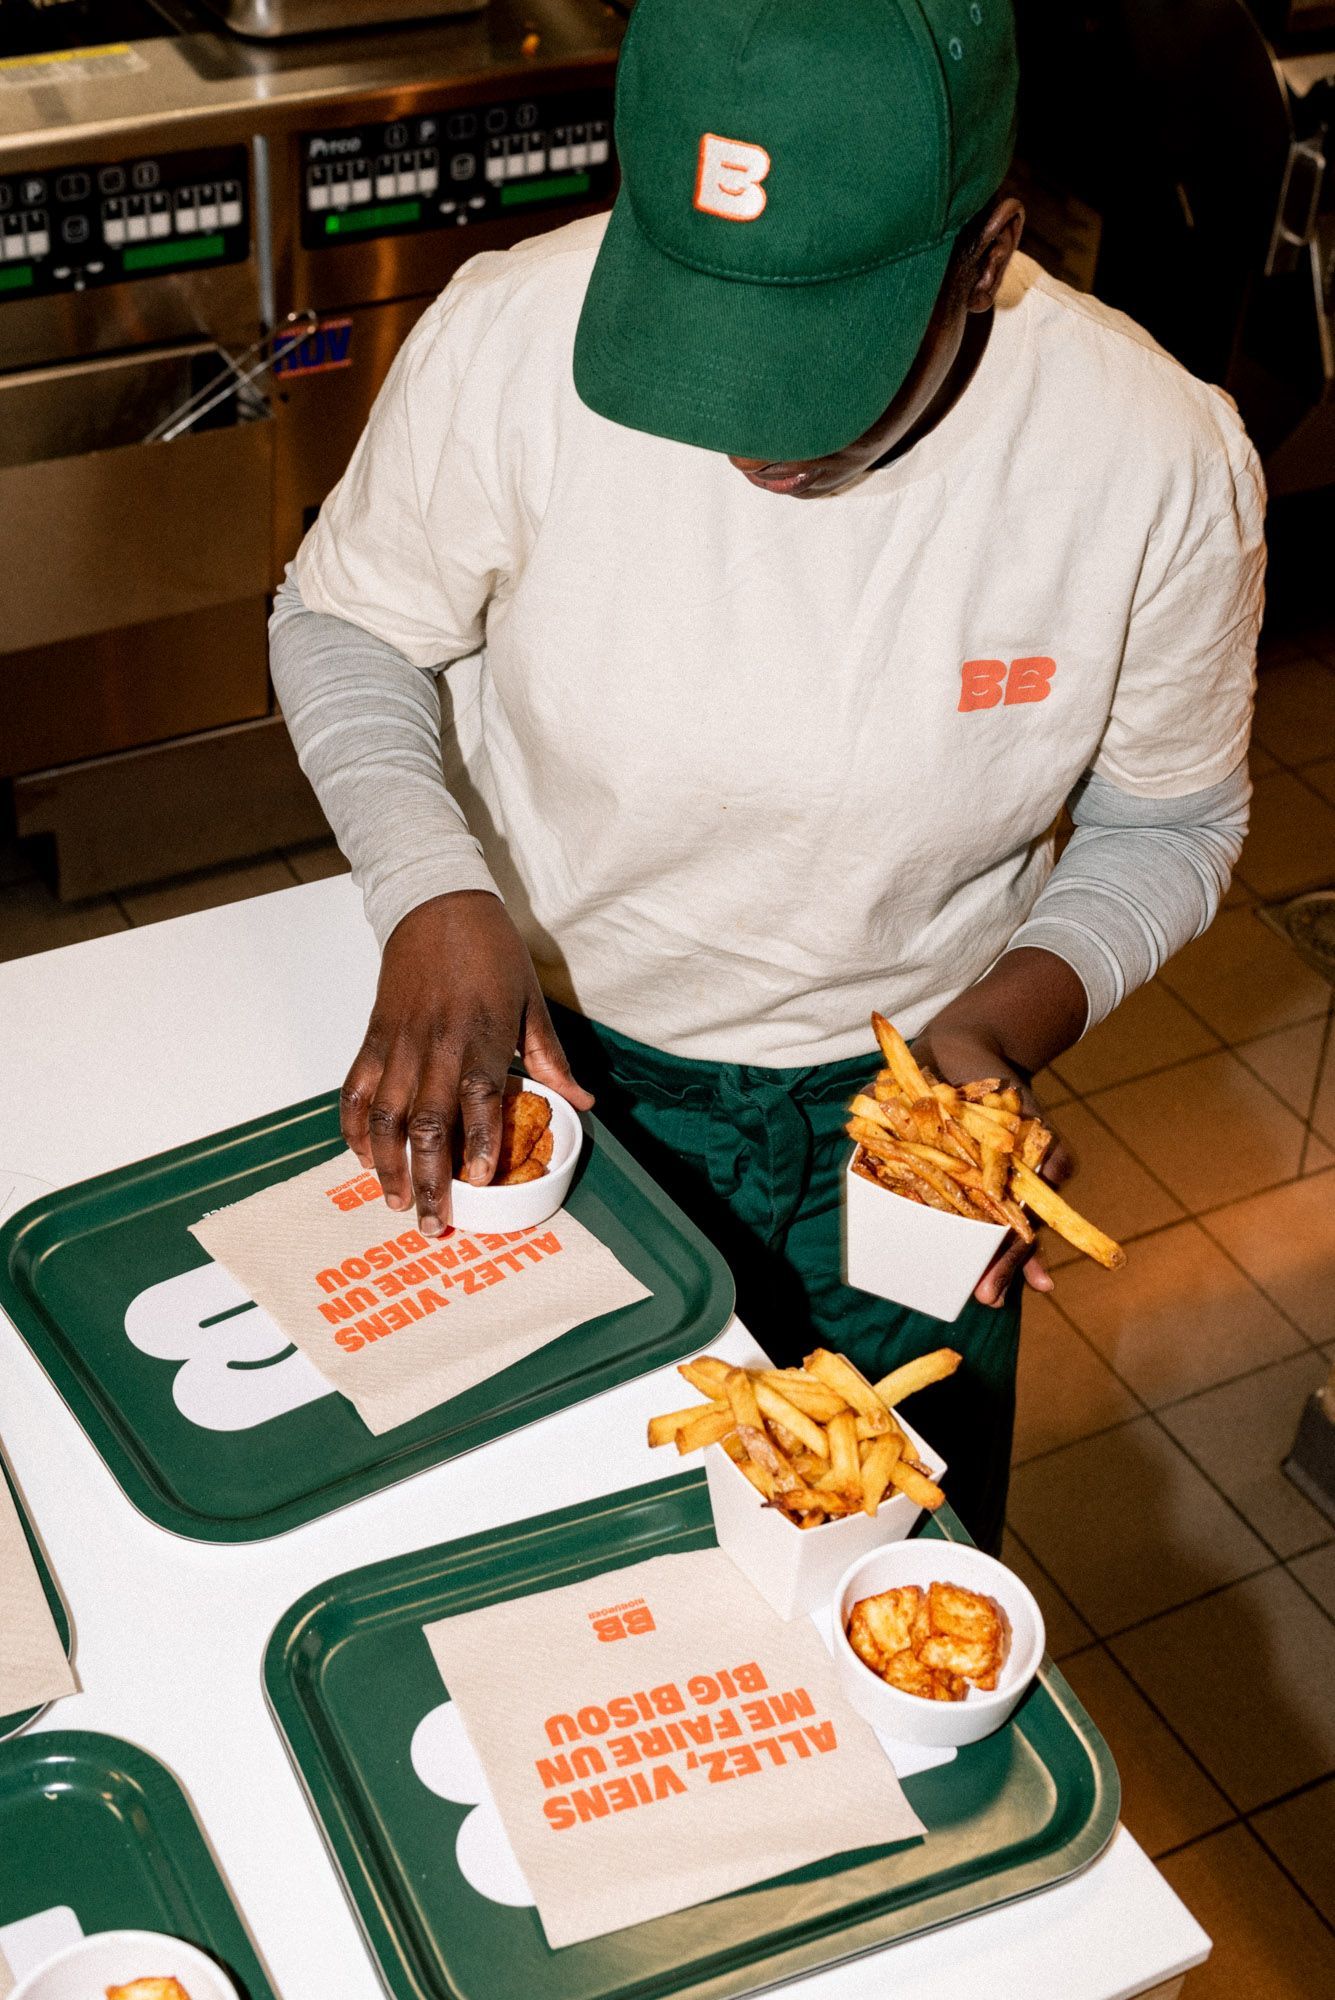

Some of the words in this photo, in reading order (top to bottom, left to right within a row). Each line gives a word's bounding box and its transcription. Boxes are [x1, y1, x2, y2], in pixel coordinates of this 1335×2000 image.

[693, 132, 771, 223] B
[957, 656, 1057, 713] BB
[332, 1176, 384, 1211] BB
[315, 1230, 429, 1290] BISOU
[372, 1238, 482, 1298] FAIRE
[441, 1232, 562, 1296] ALLEZ,
[318, 1287, 380, 1325] UN
[335, 1288, 449, 1353] VIENS
[592, 1606, 657, 1642] BB
[687, 1662, 769, 1705] BIG
[741, 1688, 816, 1732] ME
[545, 1684, 686, 1747] BISOU
[607, 1709, 743, 1768] FAIRE
[536, 1745, 608, 1789] UN
[686, 1721, 838, 1784] ALLEZ,
[544, 1765, 688, 1831] VIENS
